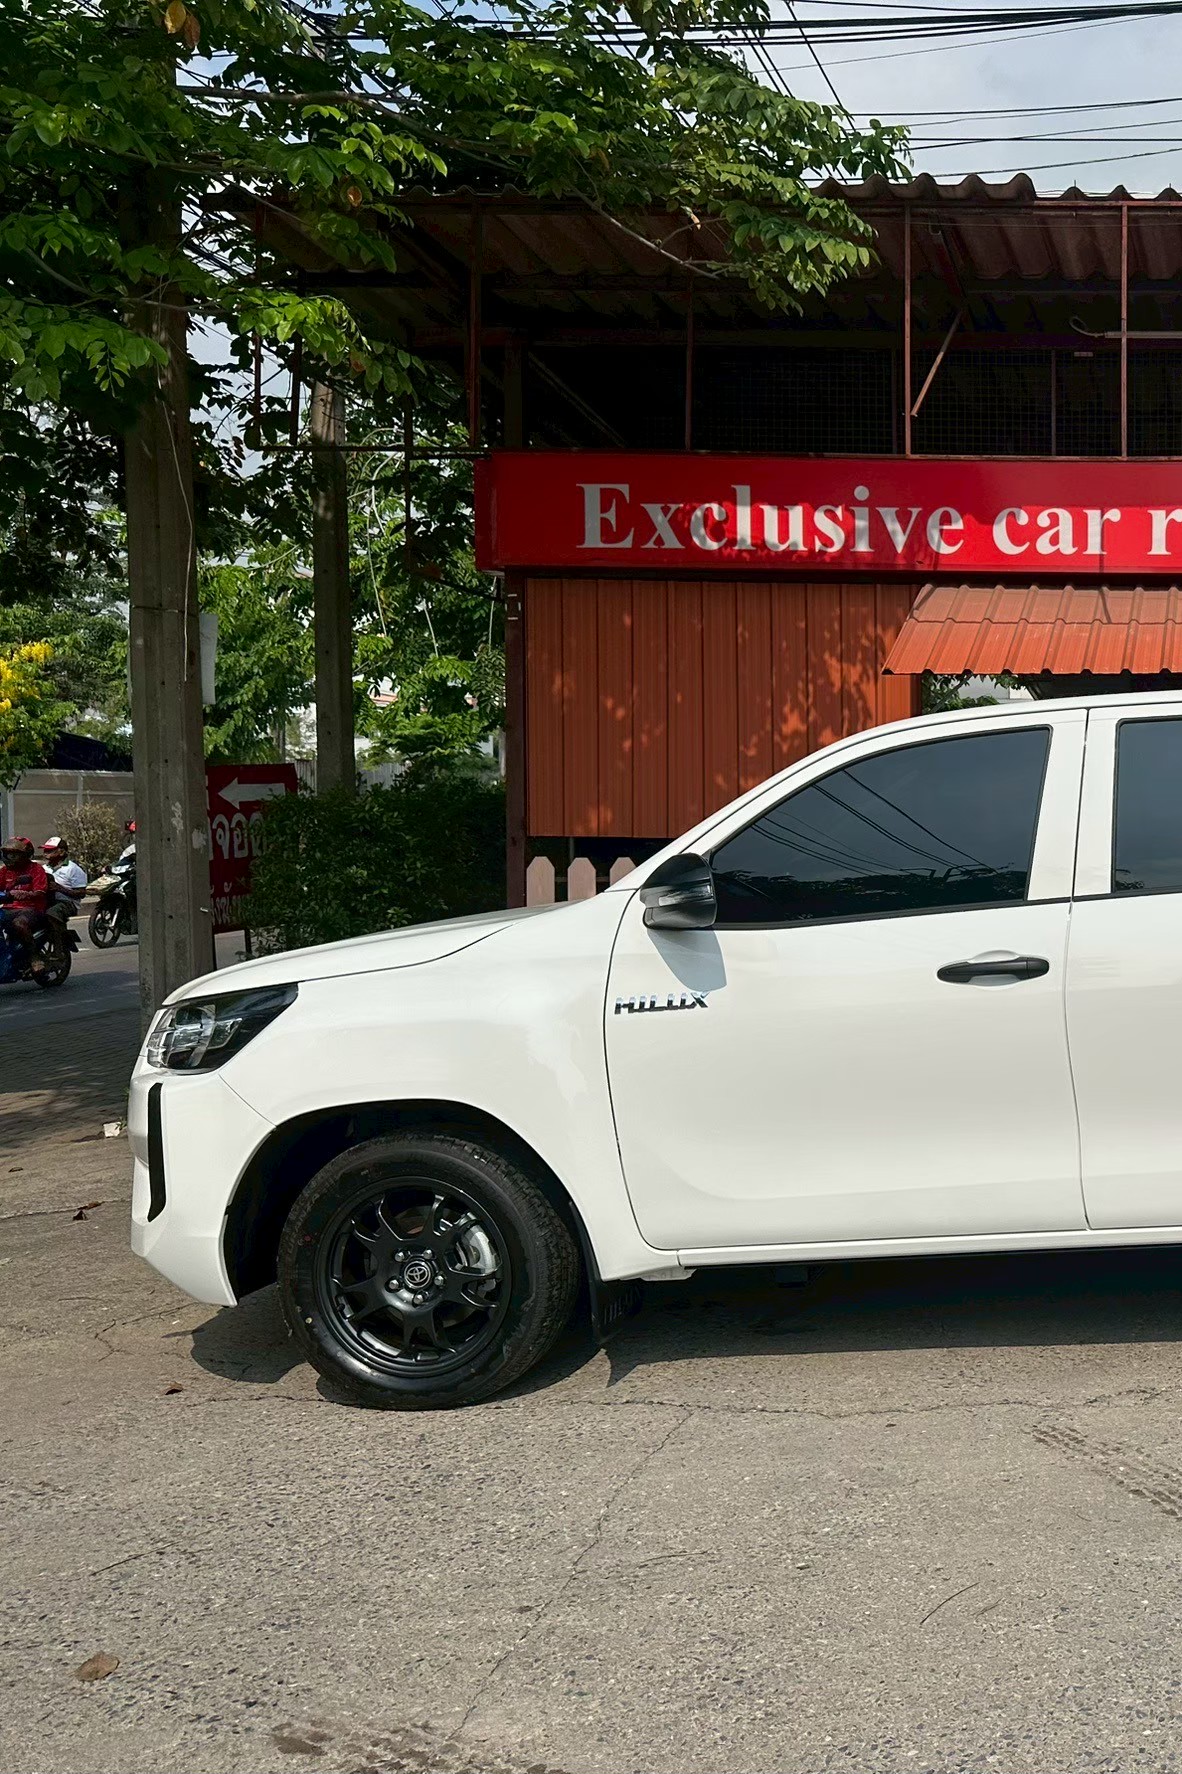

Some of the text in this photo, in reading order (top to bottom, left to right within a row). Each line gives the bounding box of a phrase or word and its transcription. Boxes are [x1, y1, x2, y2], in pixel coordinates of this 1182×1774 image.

[576, 483, 966, 555] Exclusive
[992, 505, 1121, 557] car
[614, 992, 710, 1015] HILUX
